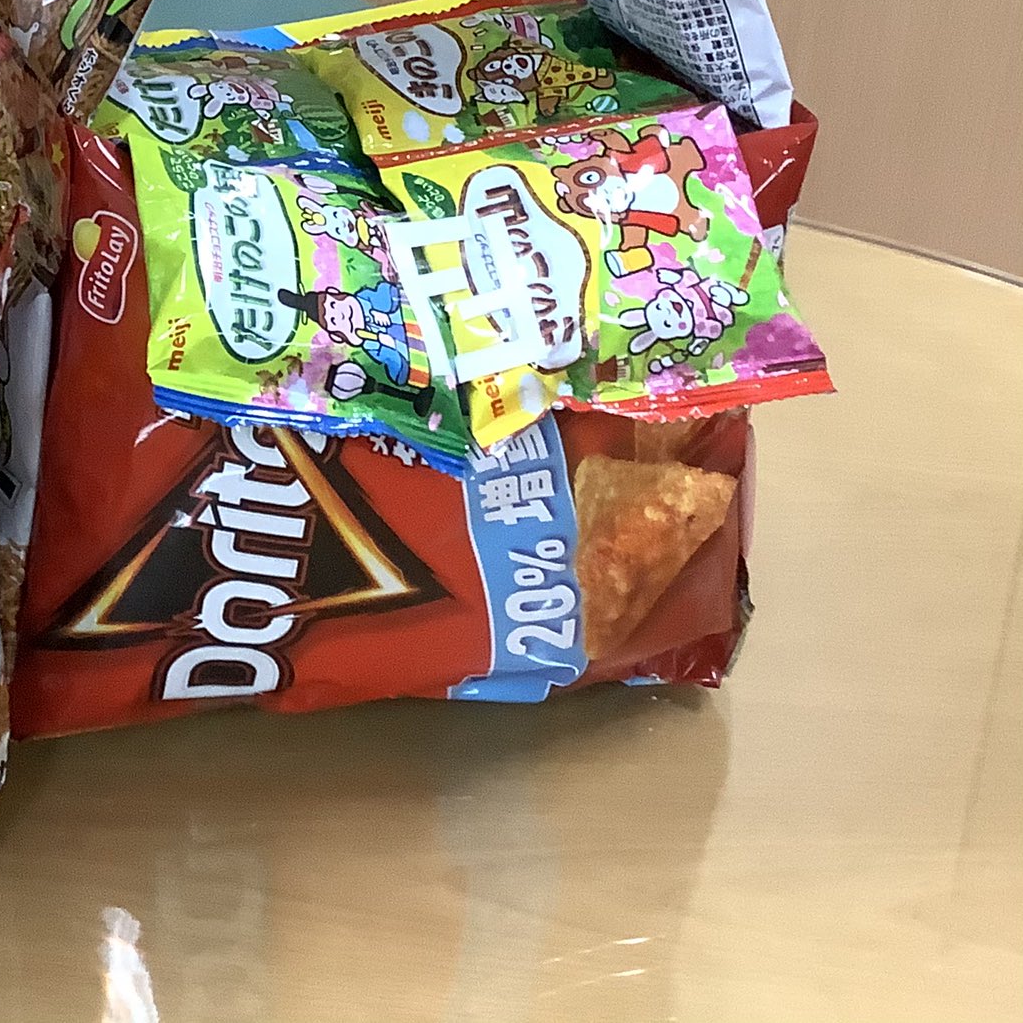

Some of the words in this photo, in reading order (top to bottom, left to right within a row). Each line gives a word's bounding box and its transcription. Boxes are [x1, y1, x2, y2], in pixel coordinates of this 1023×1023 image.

[361, 99, 392, 140] meiji
[204, 201, 223, 283] 明治チョコスナック
[166, 317, 191, 371] meiji
[478, 372, 507, 420] mei
